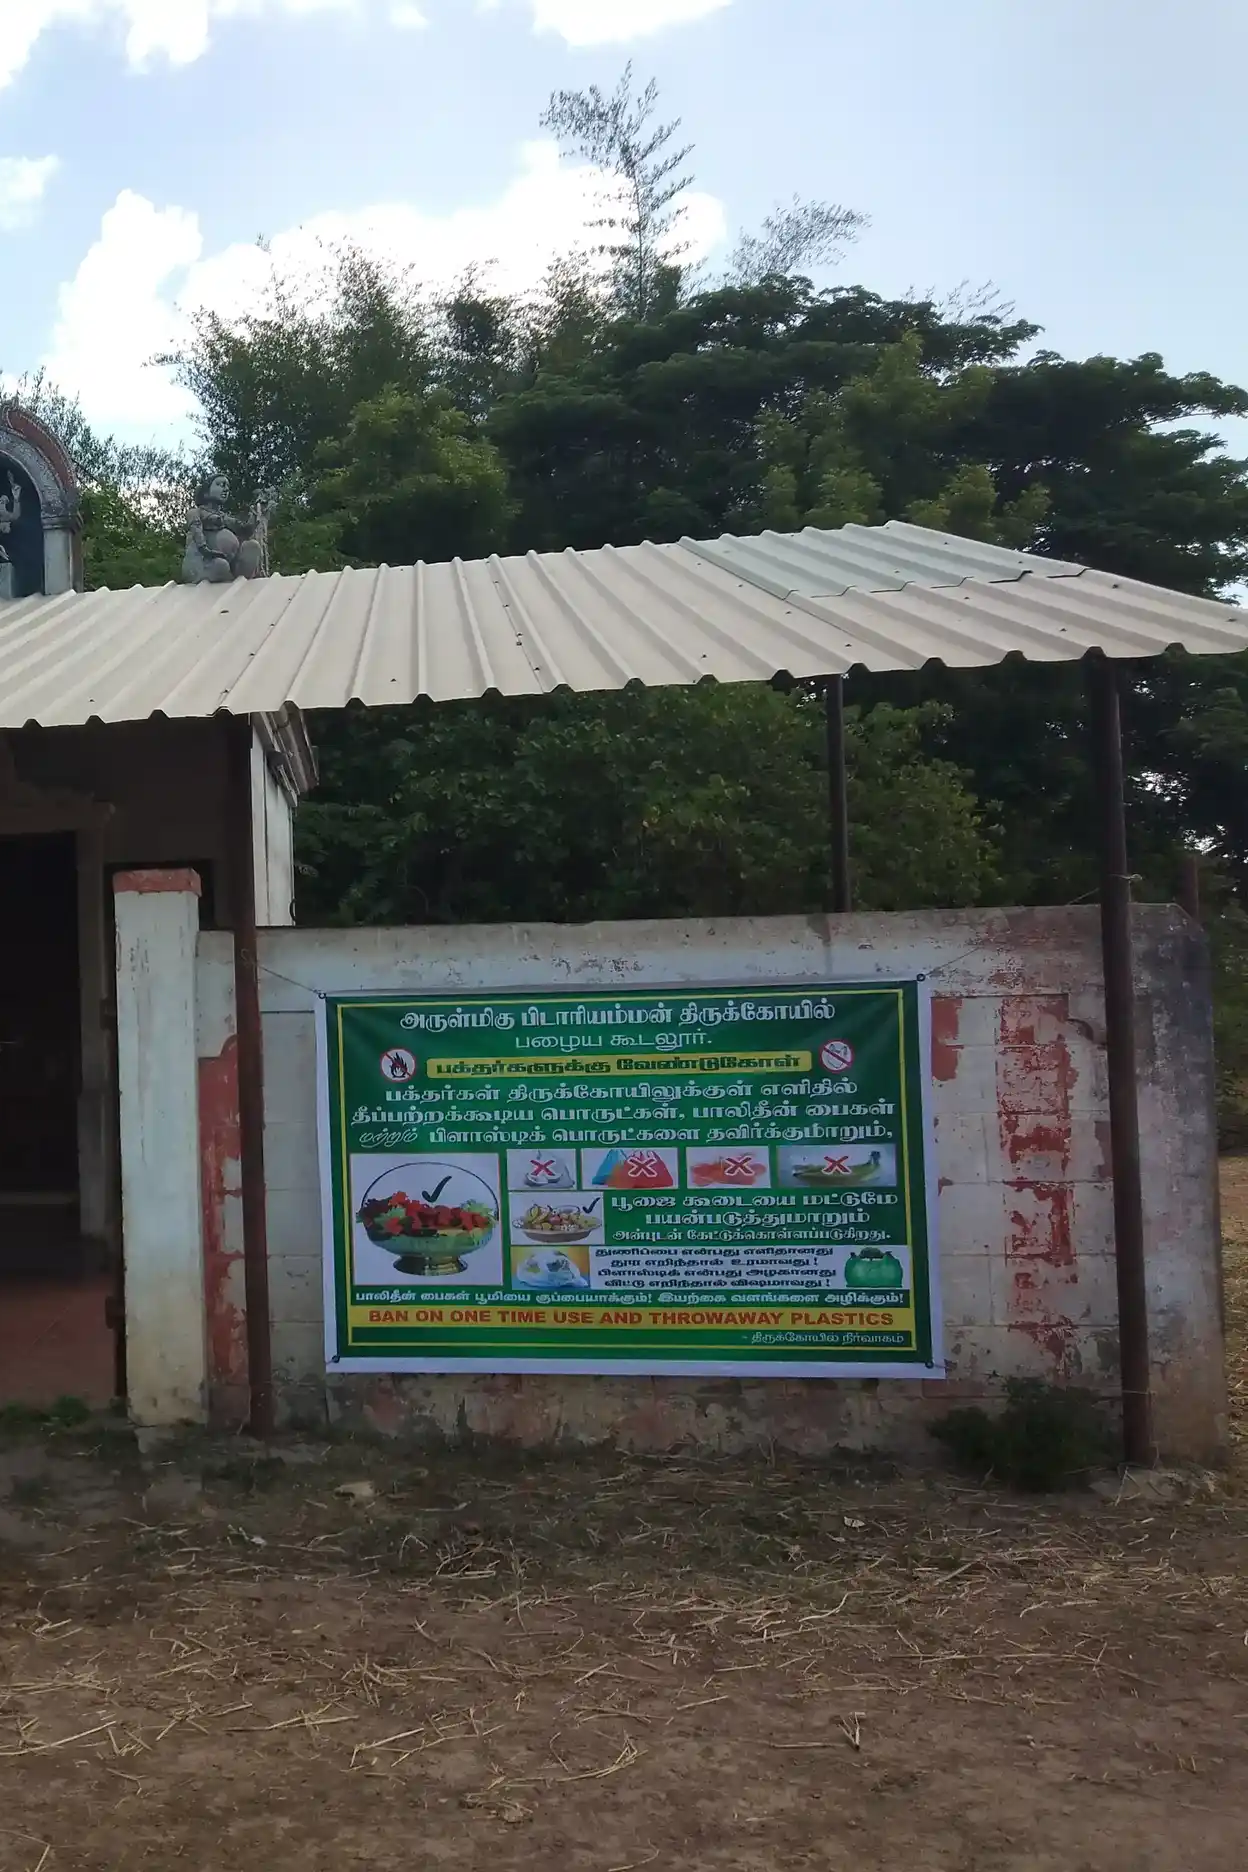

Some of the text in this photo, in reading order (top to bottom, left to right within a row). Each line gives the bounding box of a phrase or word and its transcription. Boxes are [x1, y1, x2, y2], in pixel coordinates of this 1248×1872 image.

[400, 997, 836, 1032] அருள்மிகு பிடாரியம்மன் திருக்கோயில்
[515, 1034, 603, 1052] பழைய
[436, 1054, 801, 1075] பக்தர்களுக்கு வேண்டுகோள்
[385, 1077, 858, 1104] பக்தர்கள் திருக்கோயிலுக்குள் எளிதில்
[351, 1105, 534, 1126] தீப்பற்றக்கூடிய
[693, 1100, 799, 1121] பாலிதீன்
[805, 1098, 895, 1116] பைகள்
[359, 1126, 418, 1148] மற்றும்
[429, 1126, 546, 1145] பிளாஸ்டிக்
[552, 1126, 700, 1144] பொருட்களை
[612, 1192, 898, 1211] பூஜை கூடையை மட்டுமே
[646, 1208, 870, 1227] பயன்படுத்துமாறும்
[612, 1228, 683, 1241] அன்புடன்
[356, 1290, 416, 1303] பாலிதீன்
[421, 1290, 470, 1301] பைகள்
[475, 1291, 530, 1304] பூமியை
[658, 1292, 726, 1304] இயற்கை
[731, 1292, 819, 1303] வளங்களை
[368, 1310, 894, 1326] BAN ON ONE TIME USE AND THROWAWAY PLASTICS
